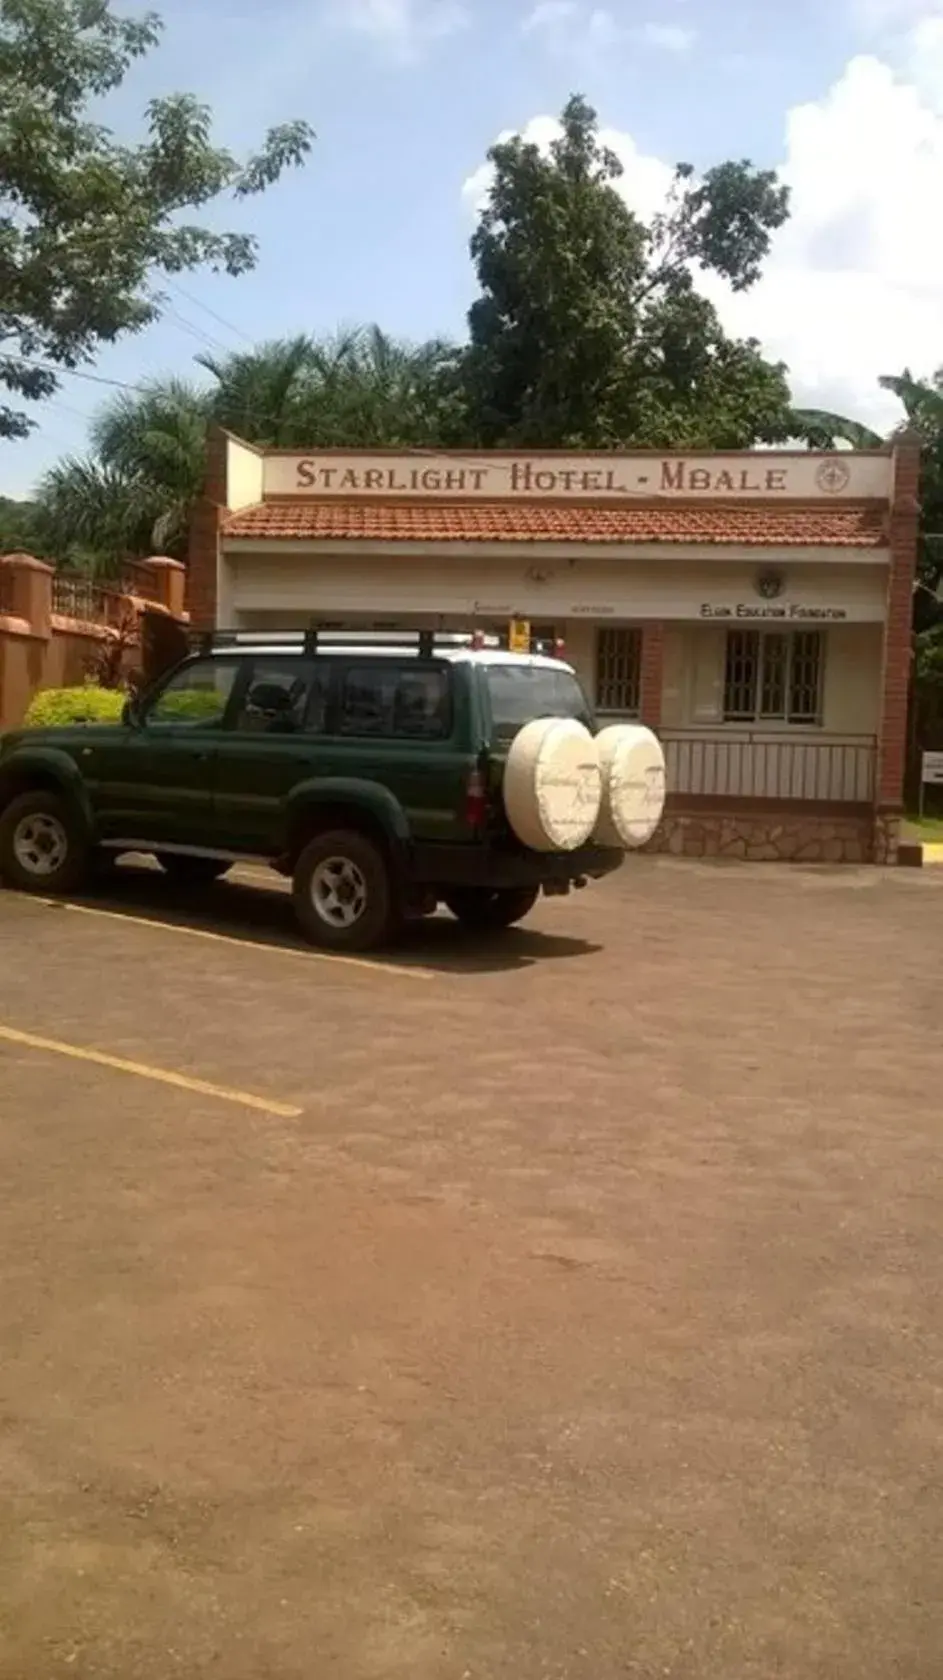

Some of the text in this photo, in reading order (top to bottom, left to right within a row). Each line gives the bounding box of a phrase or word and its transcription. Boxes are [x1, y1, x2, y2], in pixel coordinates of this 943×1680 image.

[297, 460, 488, 489] STARLIGHT
[511, 462, 626, 491] HOTEL
[660, 461, 788, 491] MBALE
